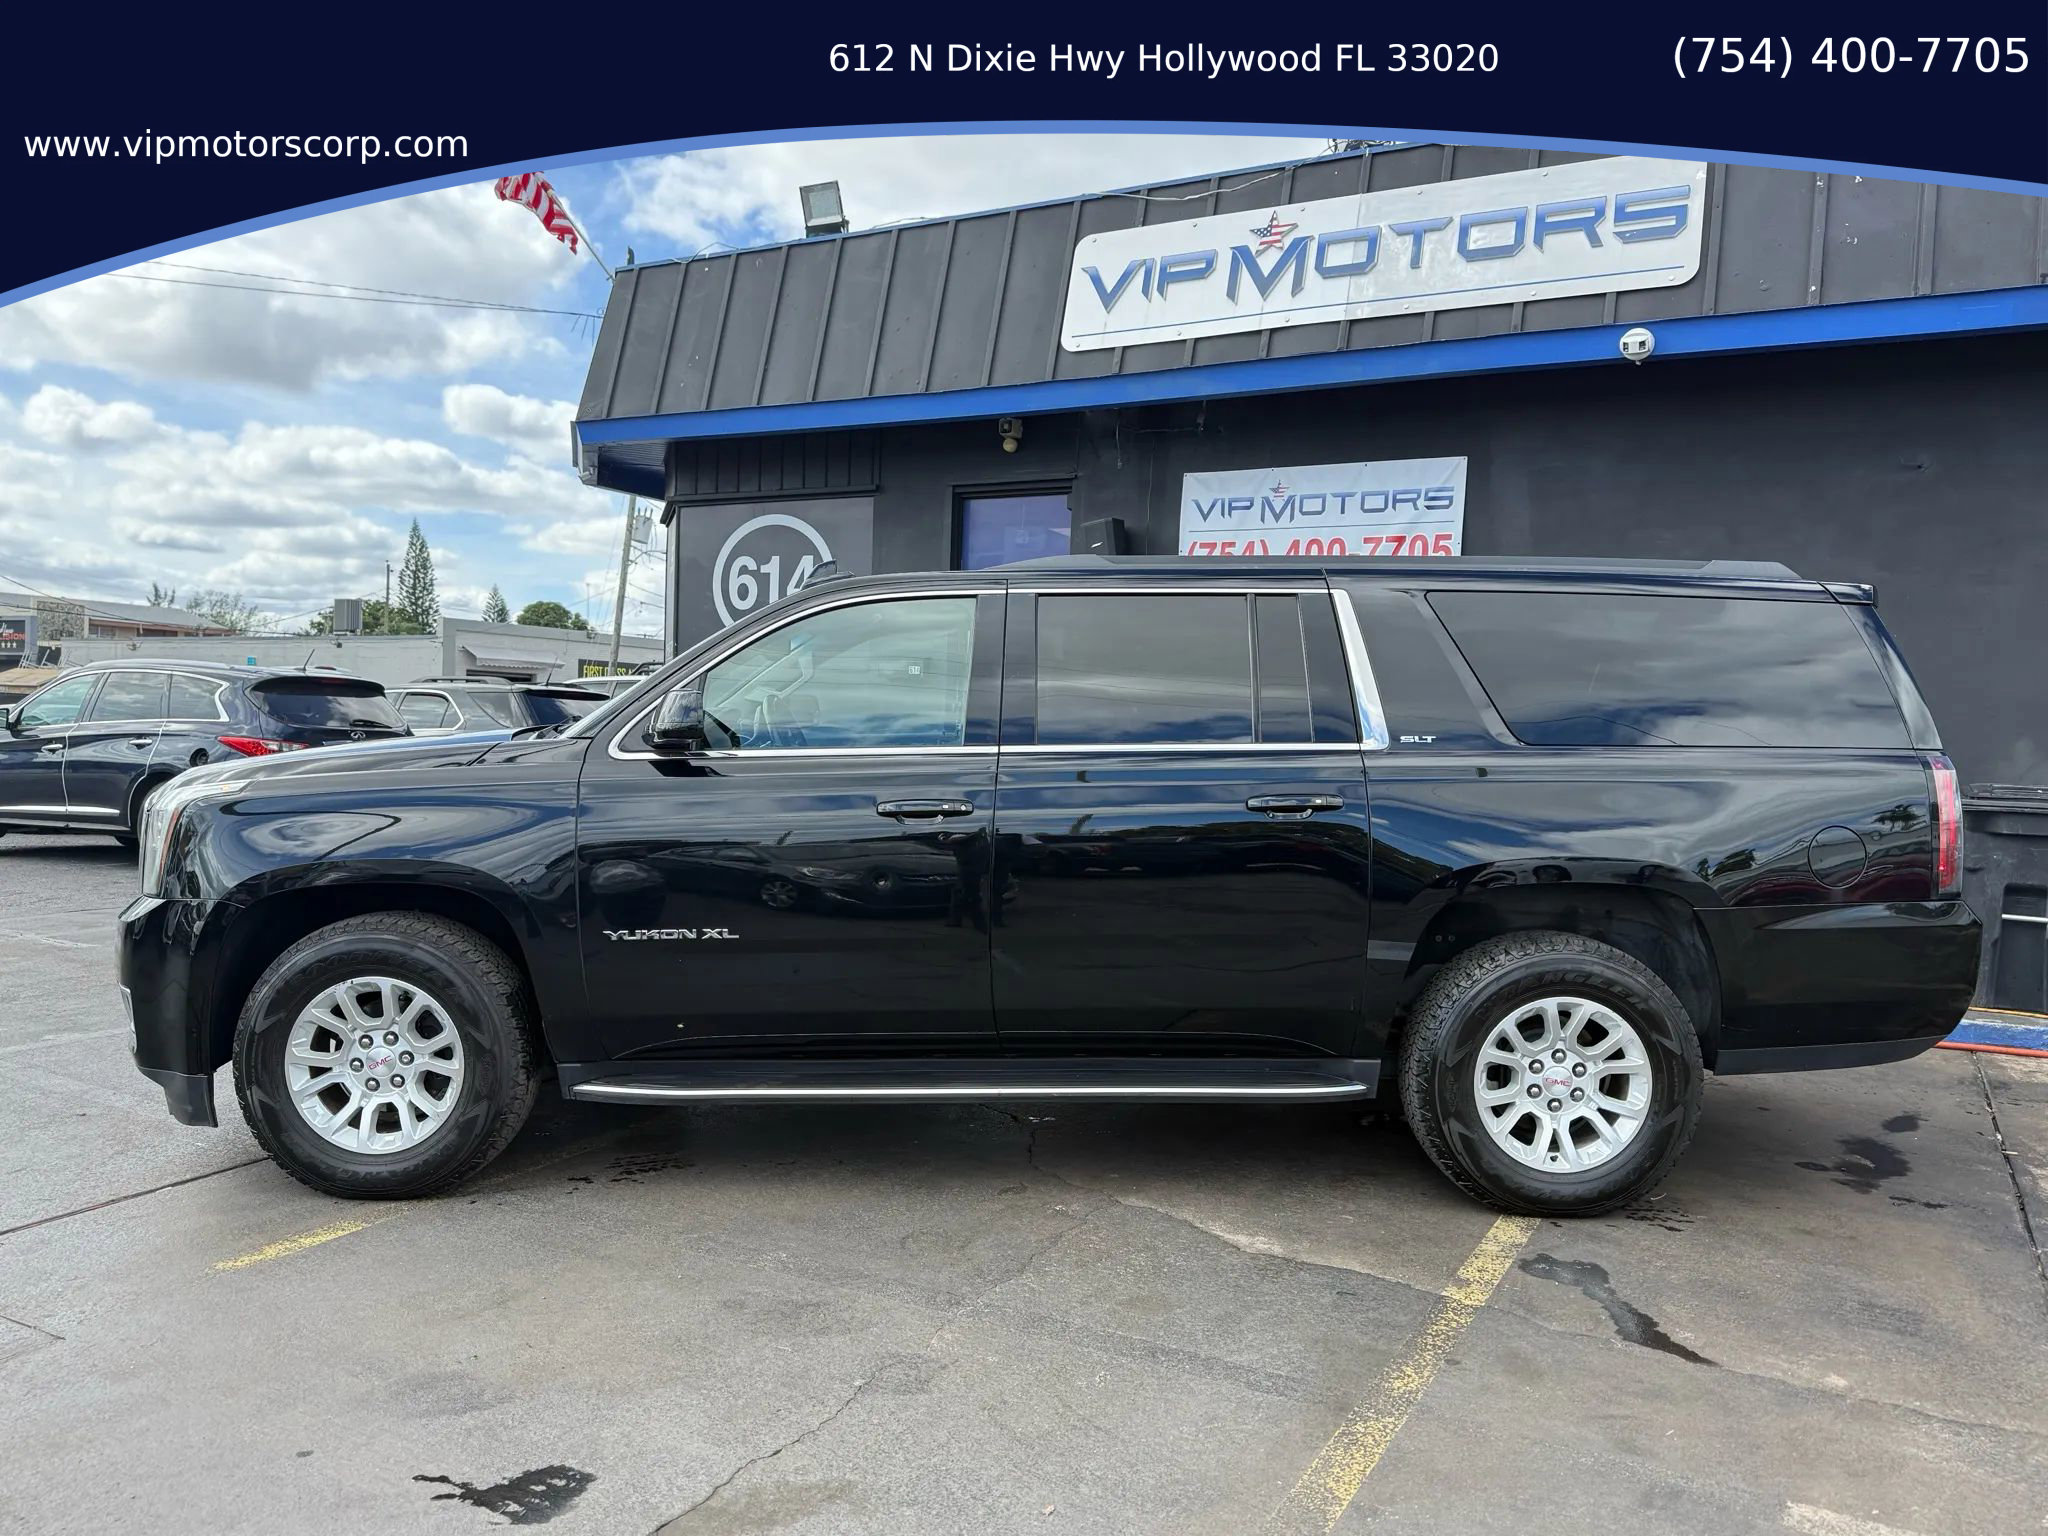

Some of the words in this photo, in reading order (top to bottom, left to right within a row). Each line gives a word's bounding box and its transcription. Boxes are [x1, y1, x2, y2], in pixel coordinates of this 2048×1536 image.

[1082, 248, 1218, 314] VIP
[1226, 184, 1691, 304] MOTORS
[1191, 496, 1255, 523] VIP
[1260, 486, 1456, 525] MOTORS
[728, 555, 815, 611] 614
[583, 665, 603, 678] FIRST
[1400, 735, 1437, 744] SLT
[602, 928, 697, 941] YUKON
[701, 928, 740, 940] XL
[368, 1055, 392, 1070] GMC
[1545, 1077, 1571, 1088] GMC
